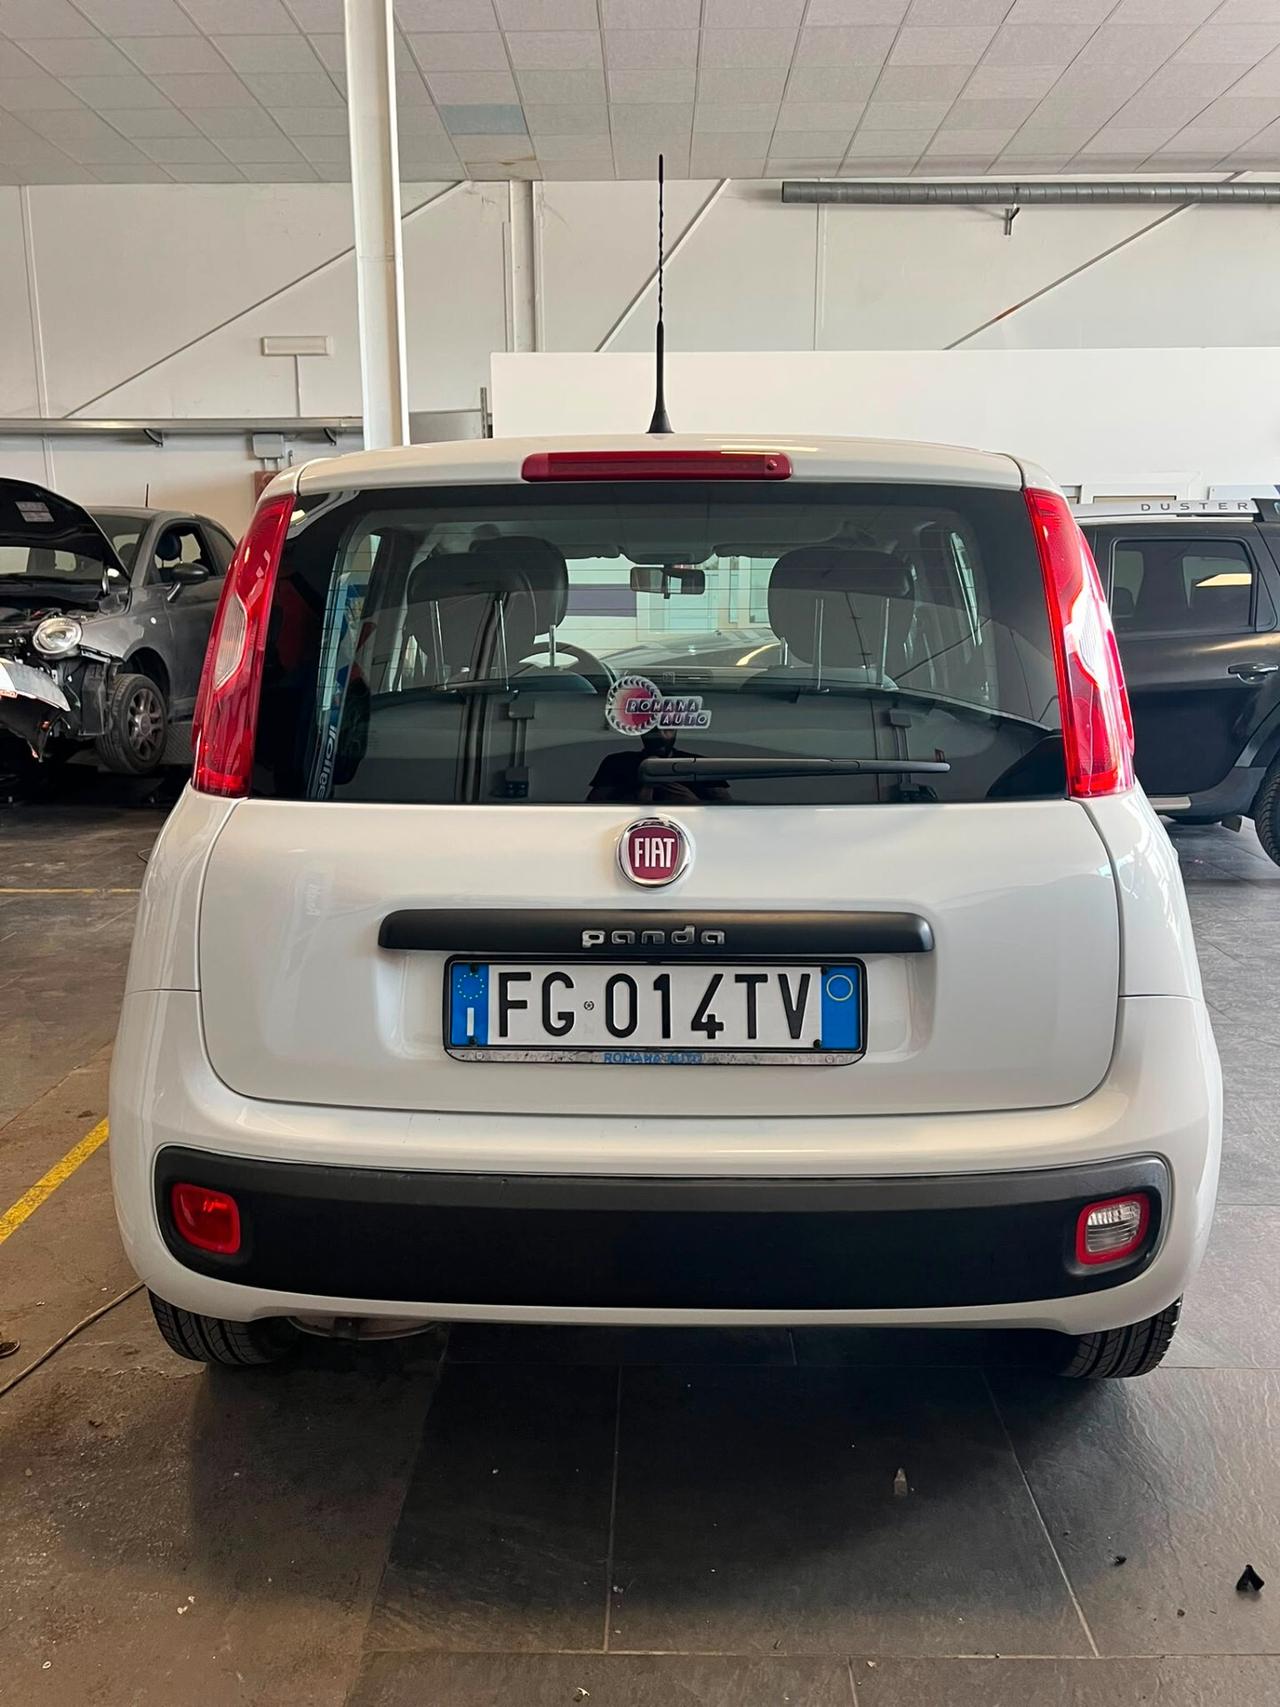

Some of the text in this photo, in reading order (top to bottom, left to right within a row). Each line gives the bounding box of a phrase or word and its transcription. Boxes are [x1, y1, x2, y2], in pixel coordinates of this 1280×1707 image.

[1140, 502, 1249, 512] DUSTER
[628, 699, 698, 713] ROMANA
[662, 713, 708, 725] AUTO
[634, 837, 675, 868] FIAT
[581, 924, 726, 949] panda
